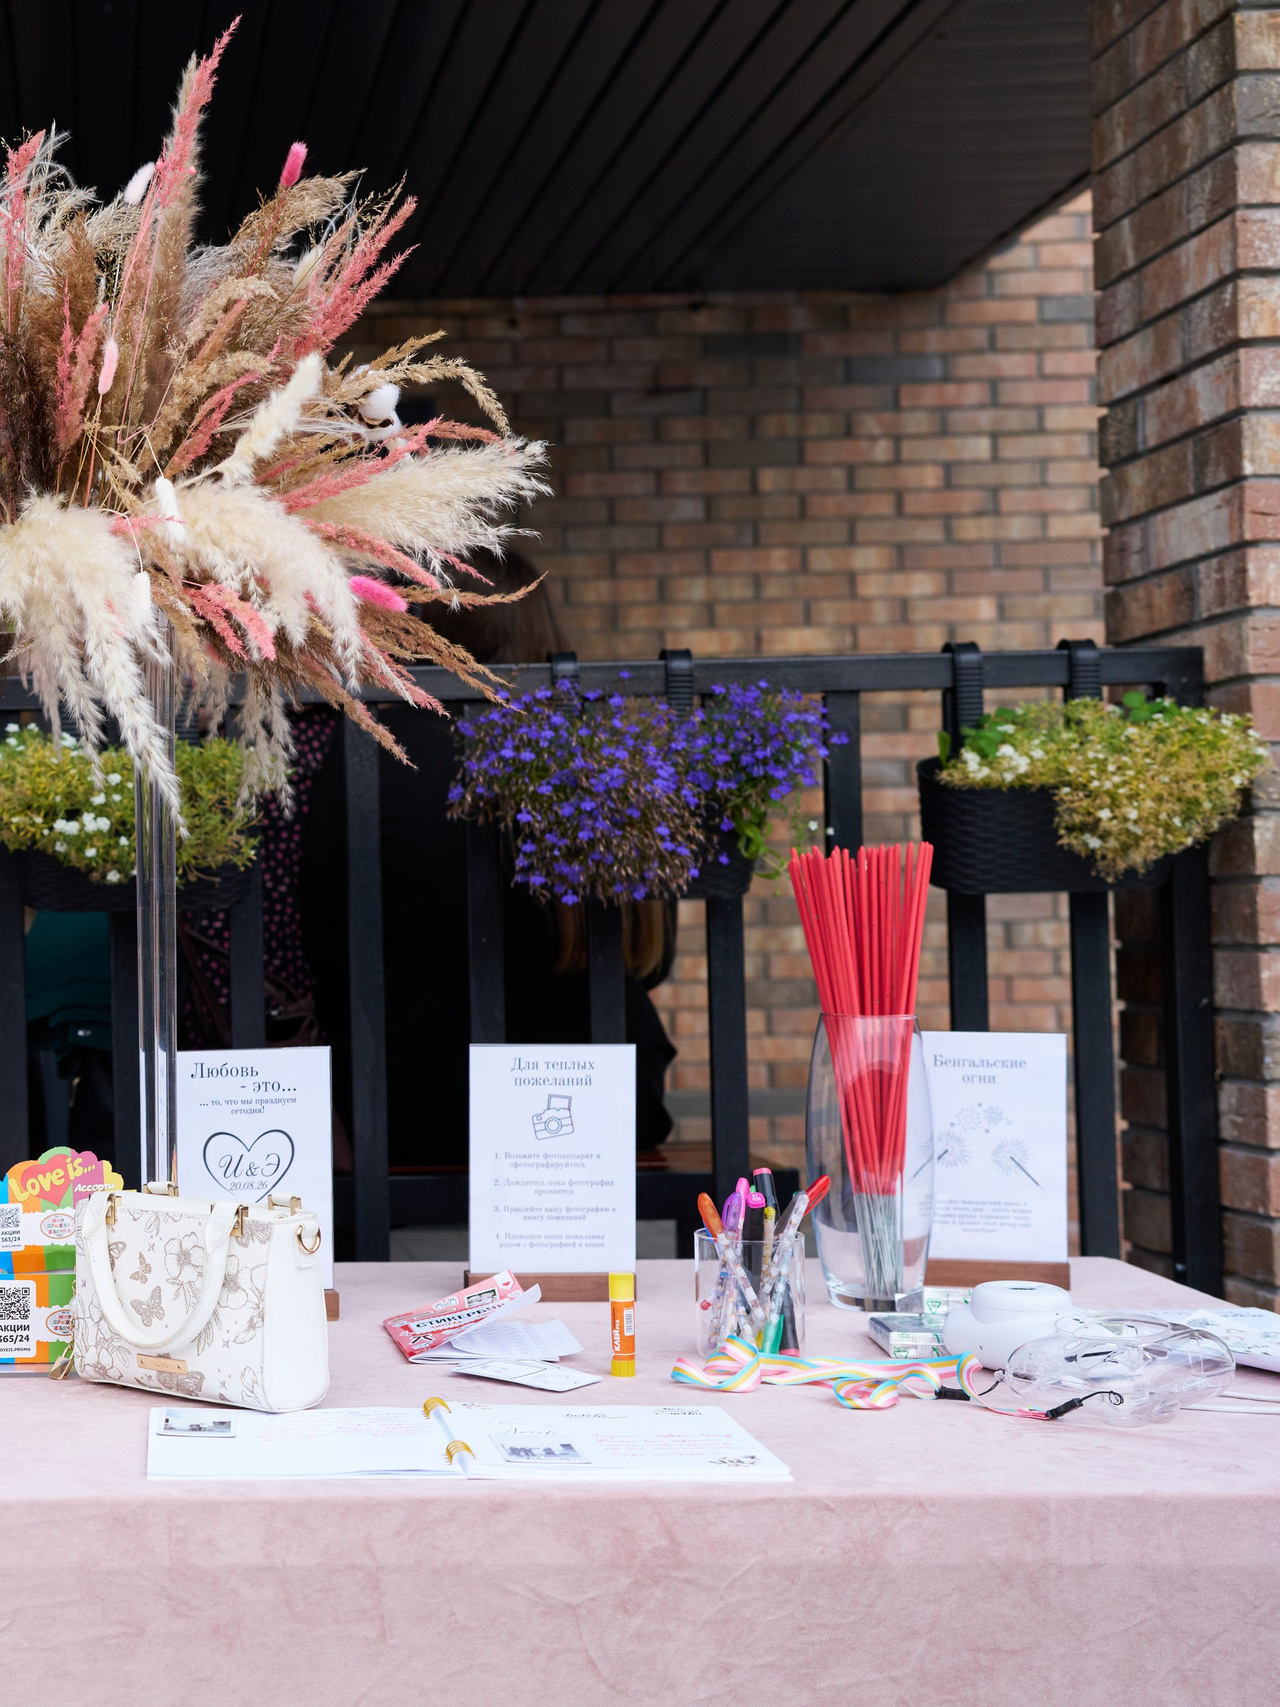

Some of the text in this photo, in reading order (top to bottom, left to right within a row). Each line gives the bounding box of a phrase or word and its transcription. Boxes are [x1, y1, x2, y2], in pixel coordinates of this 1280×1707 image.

[511, 1058, 595, 1072] Для теплых
[933, 1054, 1027, 1069] Бенгальские
[191, 1062, 259, 1079] Любовь
[514, 1075, 593, 1087] пожеланий
[962, 1073, 996, 1084] огни
[253, 1081, 297, 1093] это...
[255, 1097, 297, 1106] празднуем
[231, 1106, 265, 1115] сегодня!
[504, 1152, 541, 1160] Возьмите
[542, 1152, 594, 1163] фотоаппарат
[245, 1162, 260, 1177] &
[8, 1157, 96, 1202] Love is...
[74, 1183, 115, 1193] Ассорти
[229, 1180, 268, 1192] 20.08.26
[612, 1330, 621, 1352] КЛЕЙ
